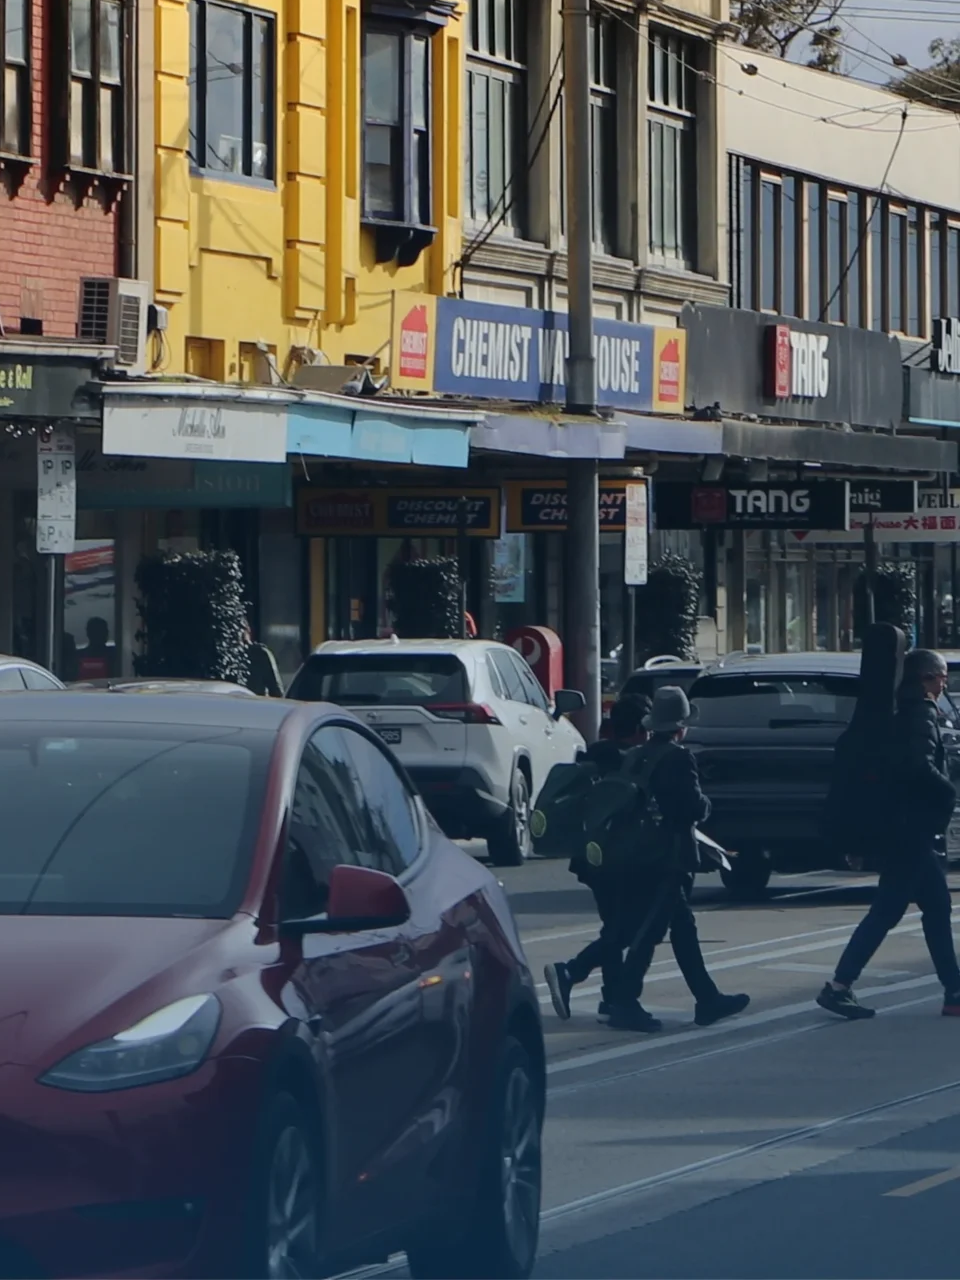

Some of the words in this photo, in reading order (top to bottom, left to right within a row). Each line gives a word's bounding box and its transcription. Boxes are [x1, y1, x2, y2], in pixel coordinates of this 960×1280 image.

[451, 316, 532, 383] CHEMIST
[538, 328, 640, 394] WAOUSE
[789, 330, 829, 398] TANG
[15, 364, 33, 389] Roll
[728, 489, 810, 513] TANG
[404, 513, 478, 525] CHEMIT
[538, 508, 620, 520] CHST
